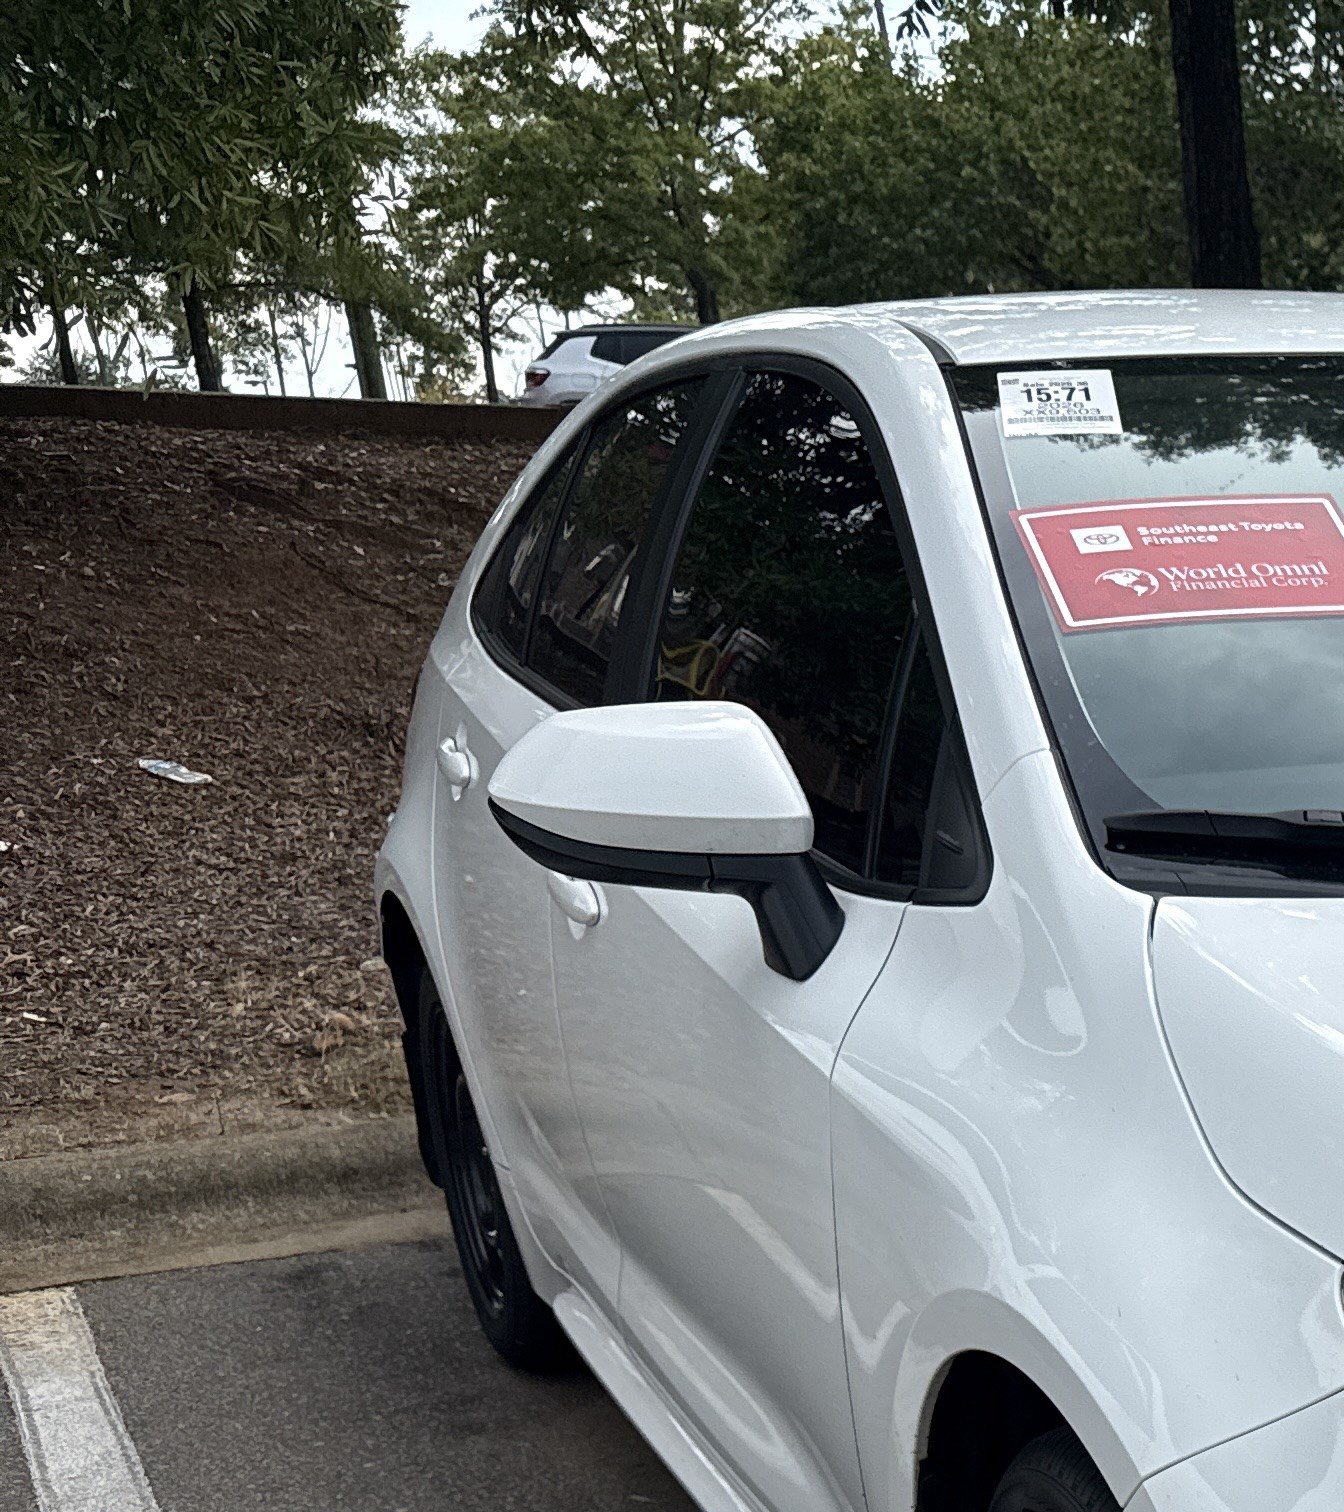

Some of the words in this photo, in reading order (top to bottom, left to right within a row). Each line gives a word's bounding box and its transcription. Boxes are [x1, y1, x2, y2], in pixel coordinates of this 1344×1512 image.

[1020, 386, 1091, 402] 15:71
[1137, 522, 1239, 535] Southeast
[1239, 521, 1305, 532] Toyota
[1142, 534, 1219, 546] Finance
[1157, 562, 1248, 580] World
[1251, 560, 1330, 577] Omni
[1169, 575, 1269, 592] Financial
[1271, 576, 1329, 589] Corp.
